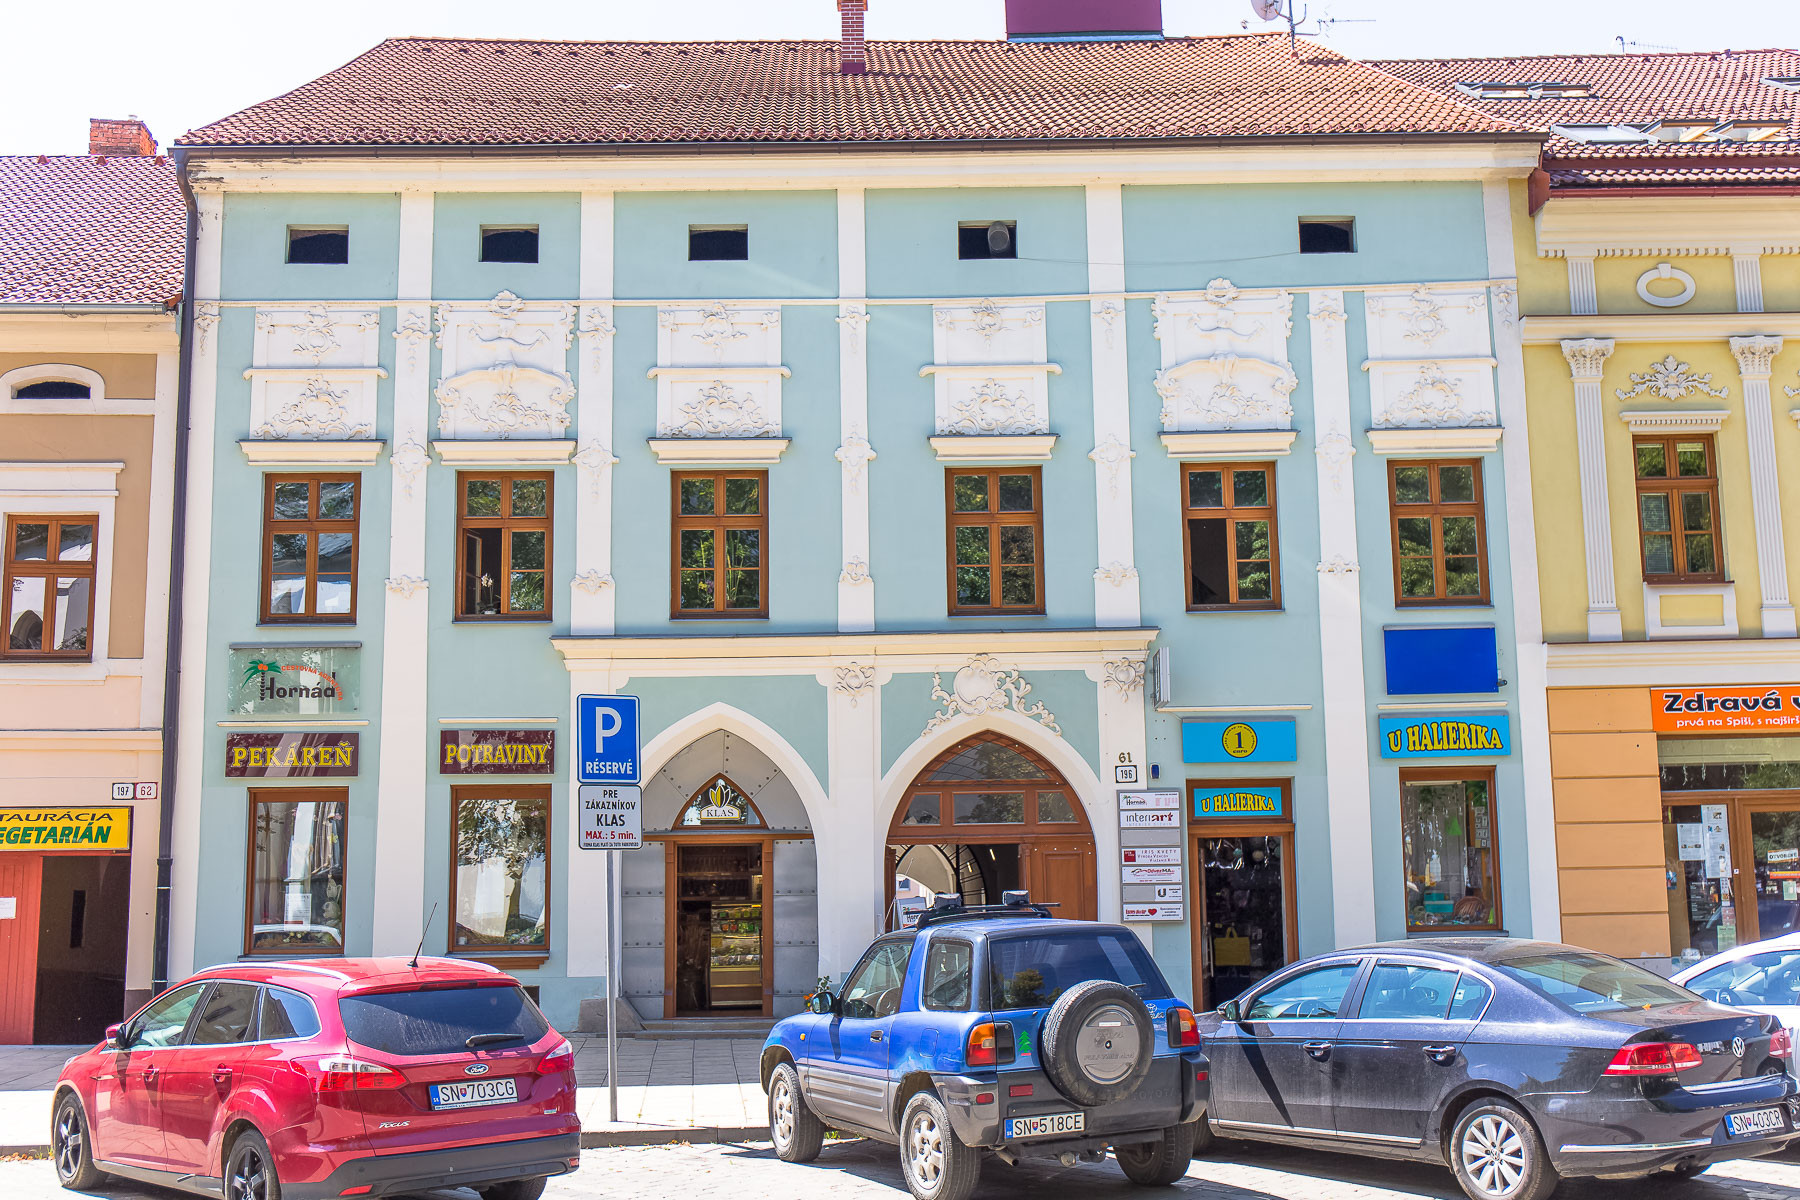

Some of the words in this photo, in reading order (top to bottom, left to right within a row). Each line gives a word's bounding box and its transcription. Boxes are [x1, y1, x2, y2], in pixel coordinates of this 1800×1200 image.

[282, 665, 318, 674] CESTOVNÁ
[1663, 690, 1782, 713] Zdravá
[1676, 718, 1704, 728] prvá
[1726, 716, 1754, 727] Spiši,
[595, 706, 622, 754] P
[1234, 732, 1244, 748] 1
[1388, 729, 1402, 752] U
[1406, 721, 1504, 752] HALIERIKA
[231, 741, 354, 767] PEKÁREŇ
[445, 744, 550, 764] POTRAVINY
[1118, 752, 1132, 763] 61
[585, 758, 633, 774] RÉSERVÉ
[1120, 770, 1133, 779] 196
[117, 786, 129, 796] 197
[140, 786, 152, 796] 62
[603, 790, 618, 798] PRE
[585, 799, 636, 810] ZÁKAZNÍKOV
[1201, 798, 1210, 812] U
[1213, 792, 1276, 812] HALIERIKA
[0, 811, 114, 822] TAURÁCIA
[706, 809, 734, 817] KLAS
[596, 814, 625, 826] KLAS
[585, 831, 608, 840] MAX.:
[610, 831, 615, 840] 5
[618, 831, 636, 840] min.
[440, 1085, 461, 1102] SN
[466, 1080, 514, 1099] 703CG
[1015, 1119, 1032, 1136] SN
[1039, 1115, 1082, 1133] 518CE
[1733, 1114, 1748, 1132] SN
[1753, 1110, 1782, 1128] 403CR
